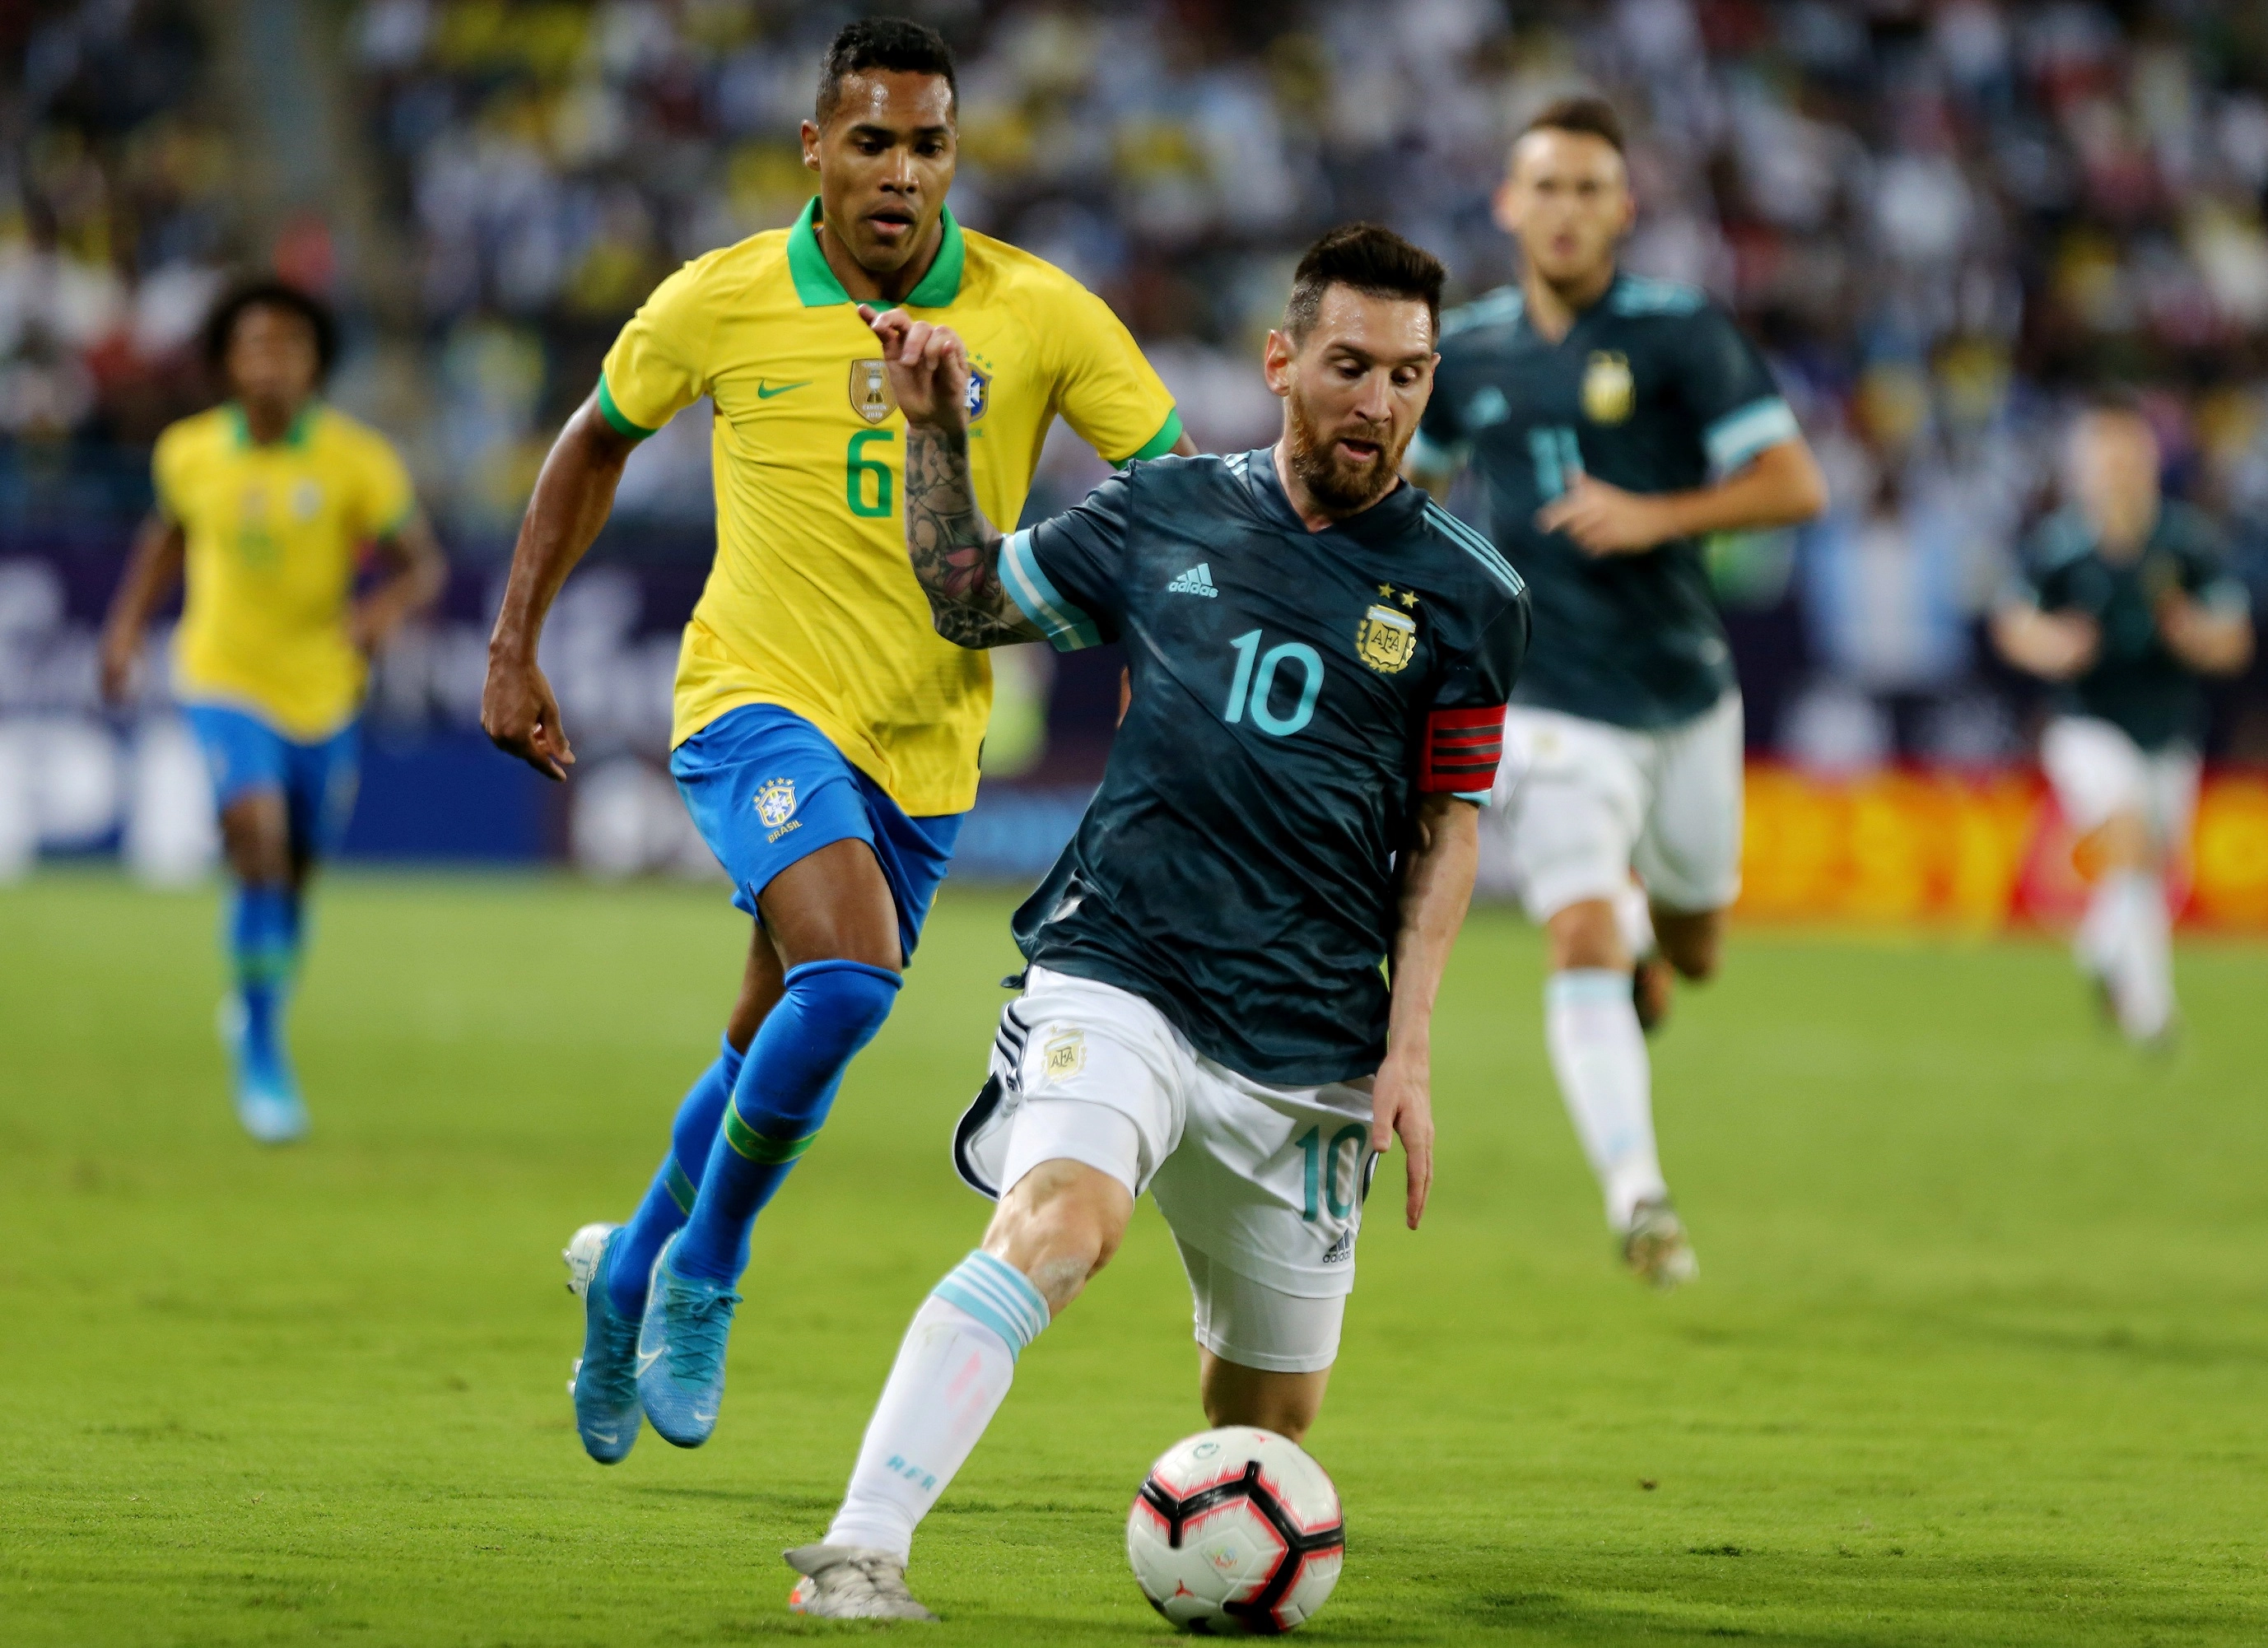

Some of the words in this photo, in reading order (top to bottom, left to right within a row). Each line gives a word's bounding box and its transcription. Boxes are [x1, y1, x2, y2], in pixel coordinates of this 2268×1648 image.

[847, 431, 894, 517] 6
[1168, 579, 1218, 598] adidas
[1371, 622, 1401, 654] AFA
[1224, 629, 1325, 736] 10
[768, 820, 803, 843] BRASIL
[1050, 1045, 1075, 1068] AFA
[1295, 1123, 1367, 1222] 10
[1321, 1249, 1351, 1264] adidas
